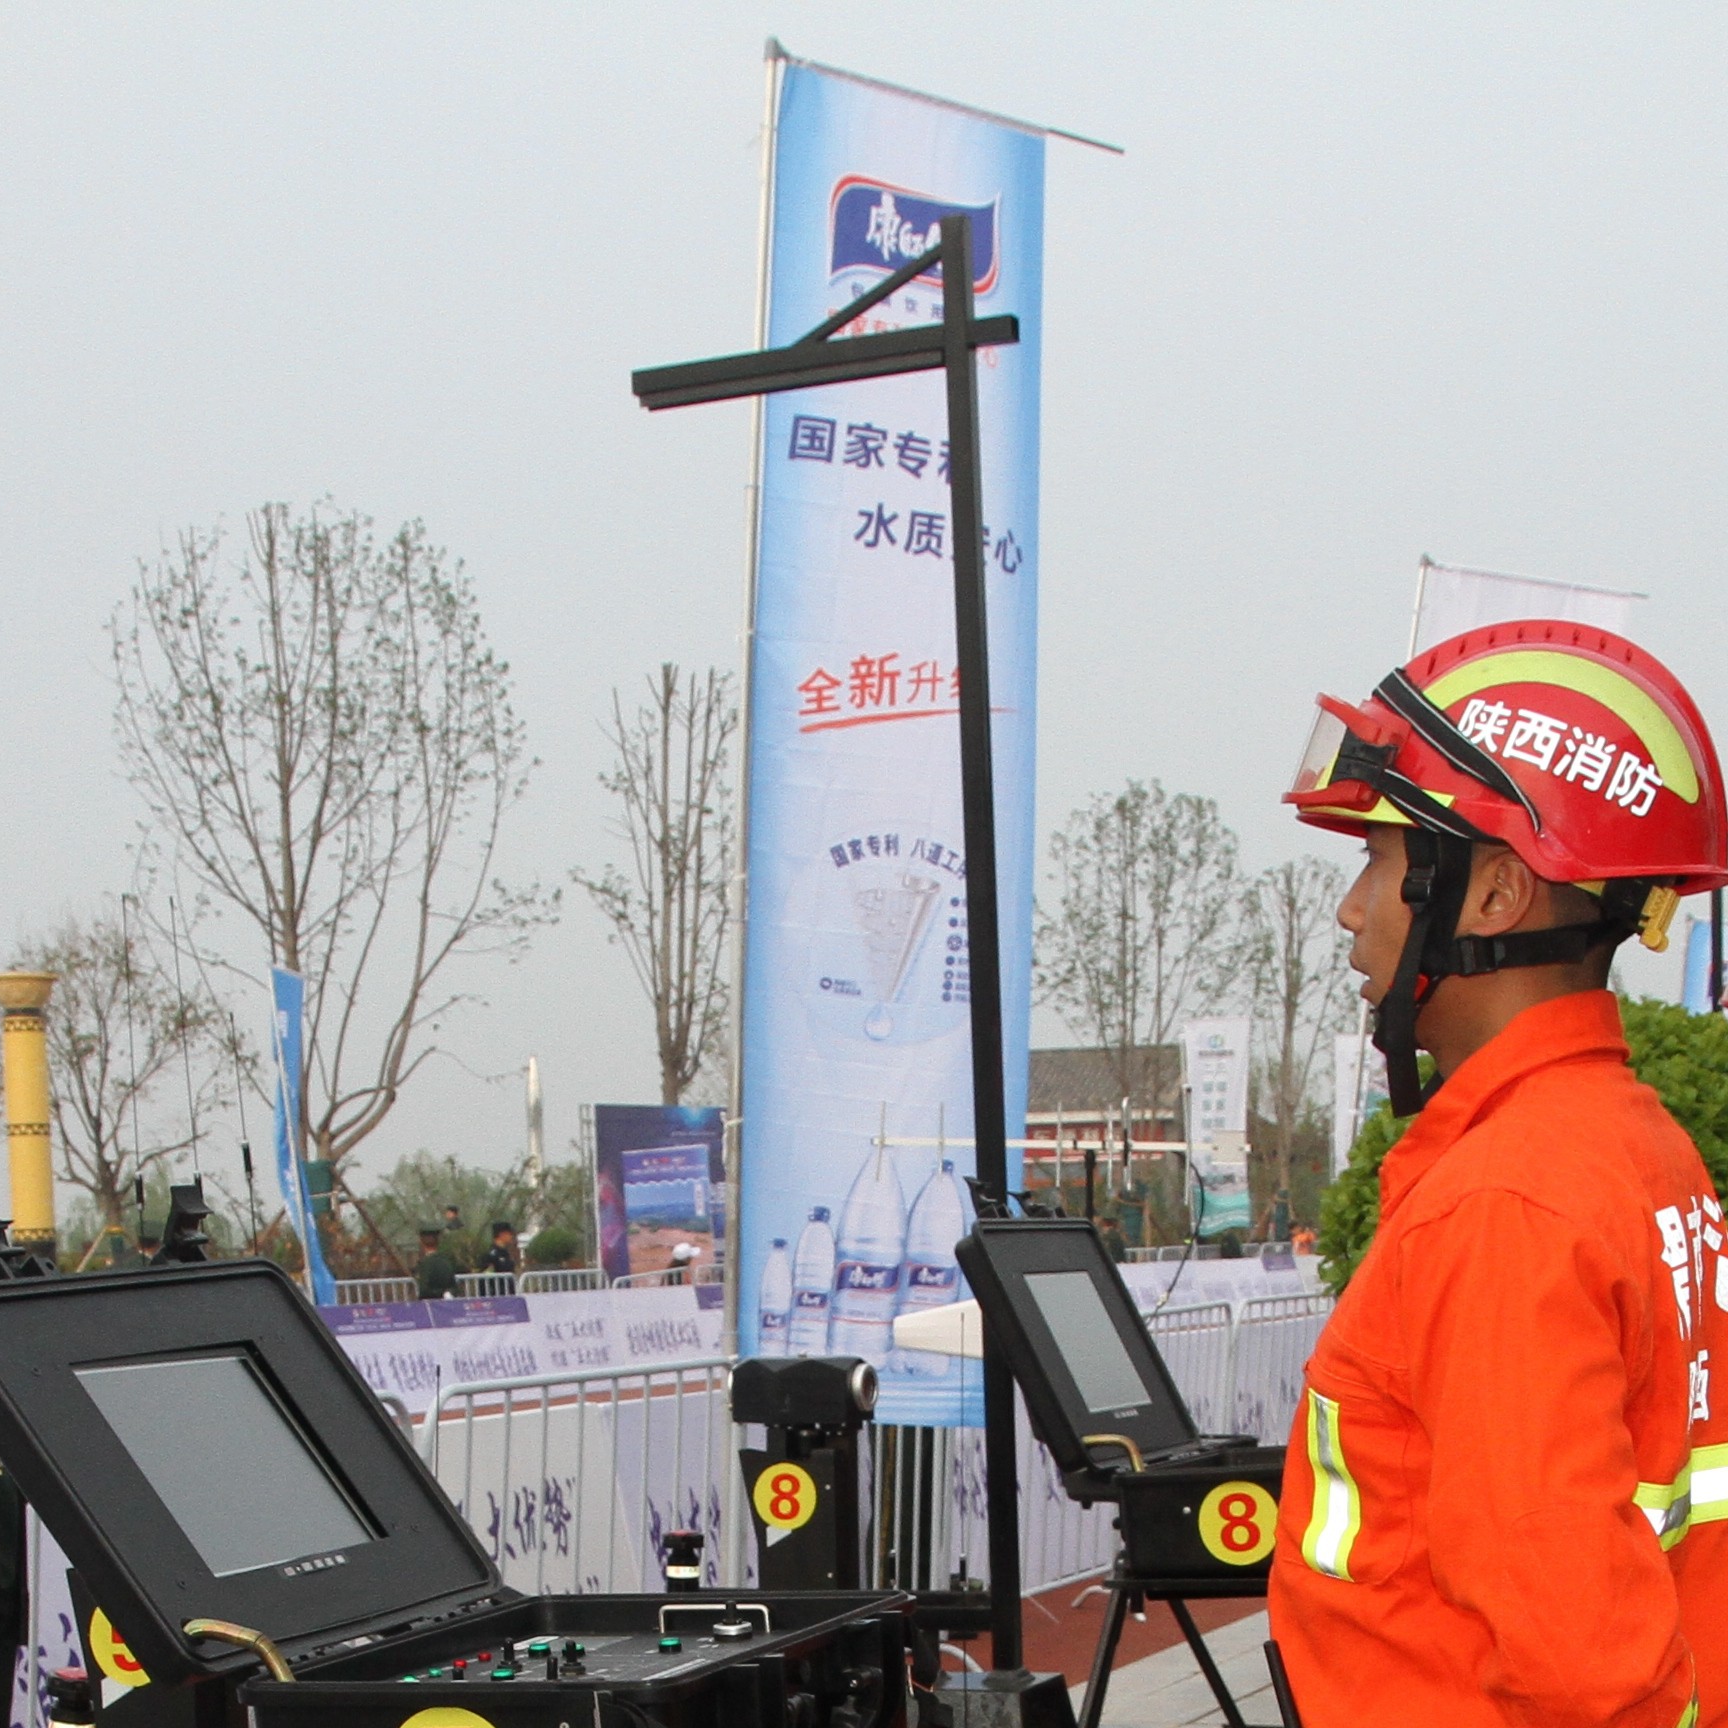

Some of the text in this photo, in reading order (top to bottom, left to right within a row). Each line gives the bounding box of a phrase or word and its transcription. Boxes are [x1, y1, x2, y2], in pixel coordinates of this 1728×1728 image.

[854, 502, 1023, 574] 水质心
[1458, 698, 1664, 817] 陕西消防
[770, 1474, 800, 1520] 8
[1218, 1493, 1261, 1553] 8
